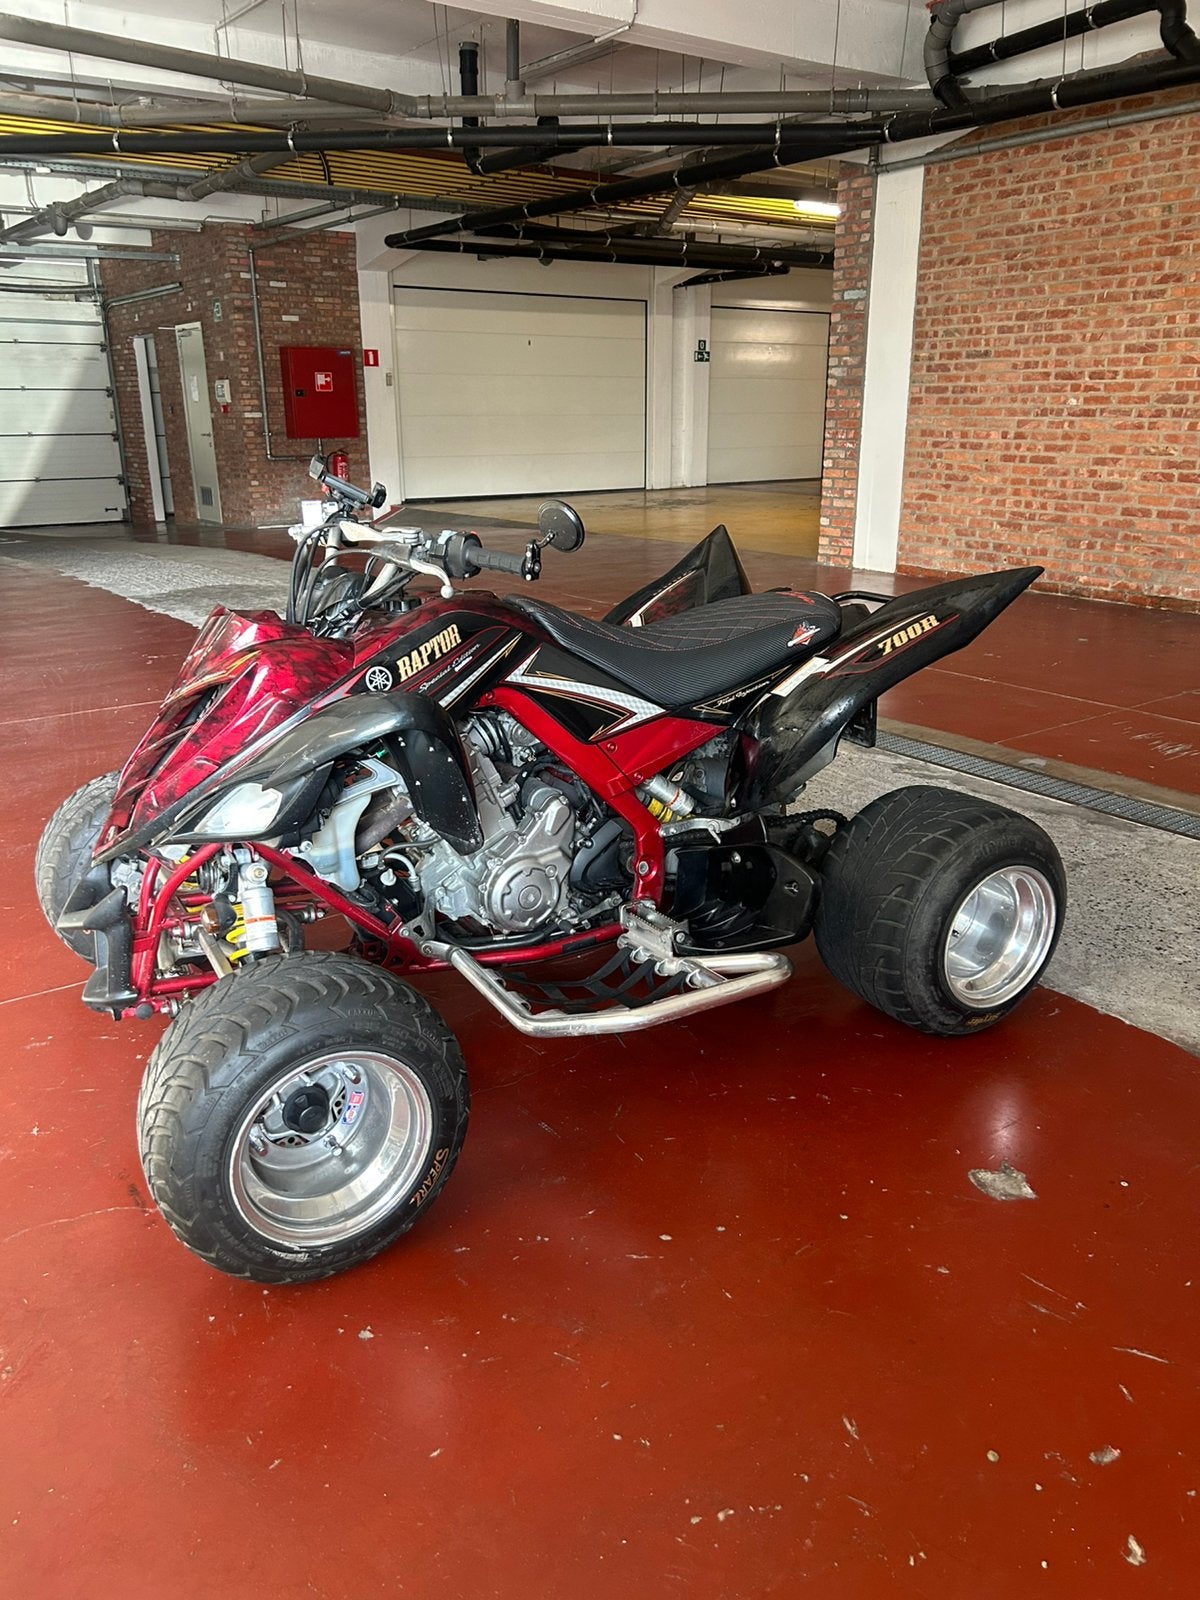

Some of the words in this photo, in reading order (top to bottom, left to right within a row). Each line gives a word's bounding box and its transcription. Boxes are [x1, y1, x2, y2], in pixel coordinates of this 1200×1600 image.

[396, 623, 462, 682] RAPTOR
[877, 614, 940, 656] 700R
[418, 665, 452, 693] Special
[409, 1147, 449, 1207] SPEARZ
